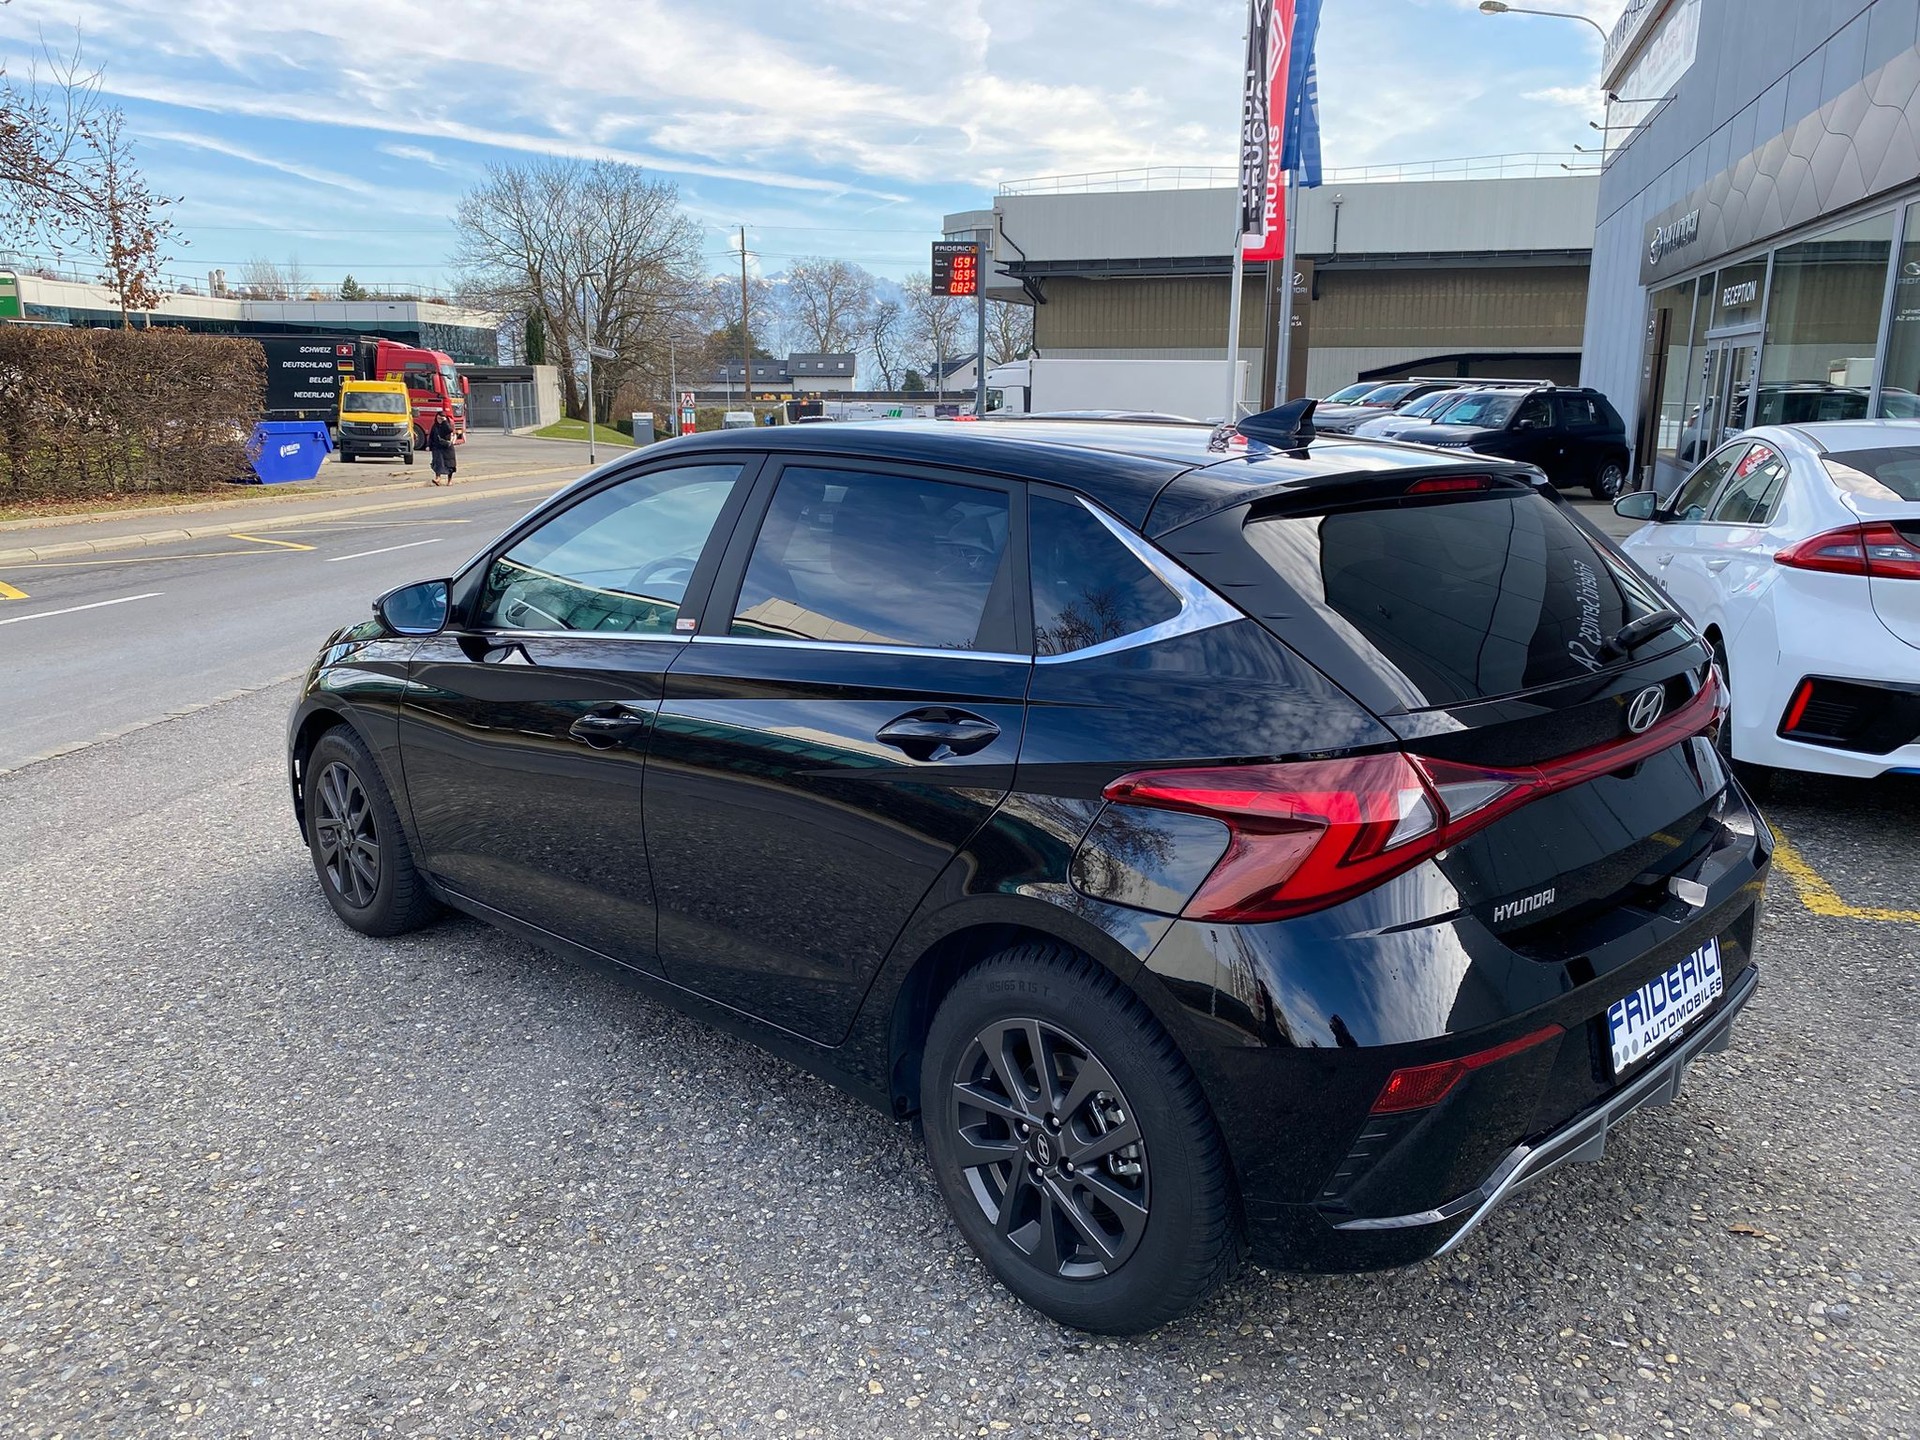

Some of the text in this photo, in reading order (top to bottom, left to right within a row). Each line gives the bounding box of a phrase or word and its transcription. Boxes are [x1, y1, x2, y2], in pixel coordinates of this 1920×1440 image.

[1264, 125, 1280, 237] TRUCKS
[1276, 286, 1308, 294] HDAI
[1722, 280, 1757, 307] RECEPTION
[299, 346, 331, 354] SCHWEIZ
[282, 361, 333, 369] DEUTSCHLAND
[293, 391, 335, 399] NEDERLAND
[1493, 887, 1556, 923] HYUNDAI
[1607, 935, 1722, 1047] FRIDERICI
[1643, 976, 1722, 1048] AUTOMOBILES
